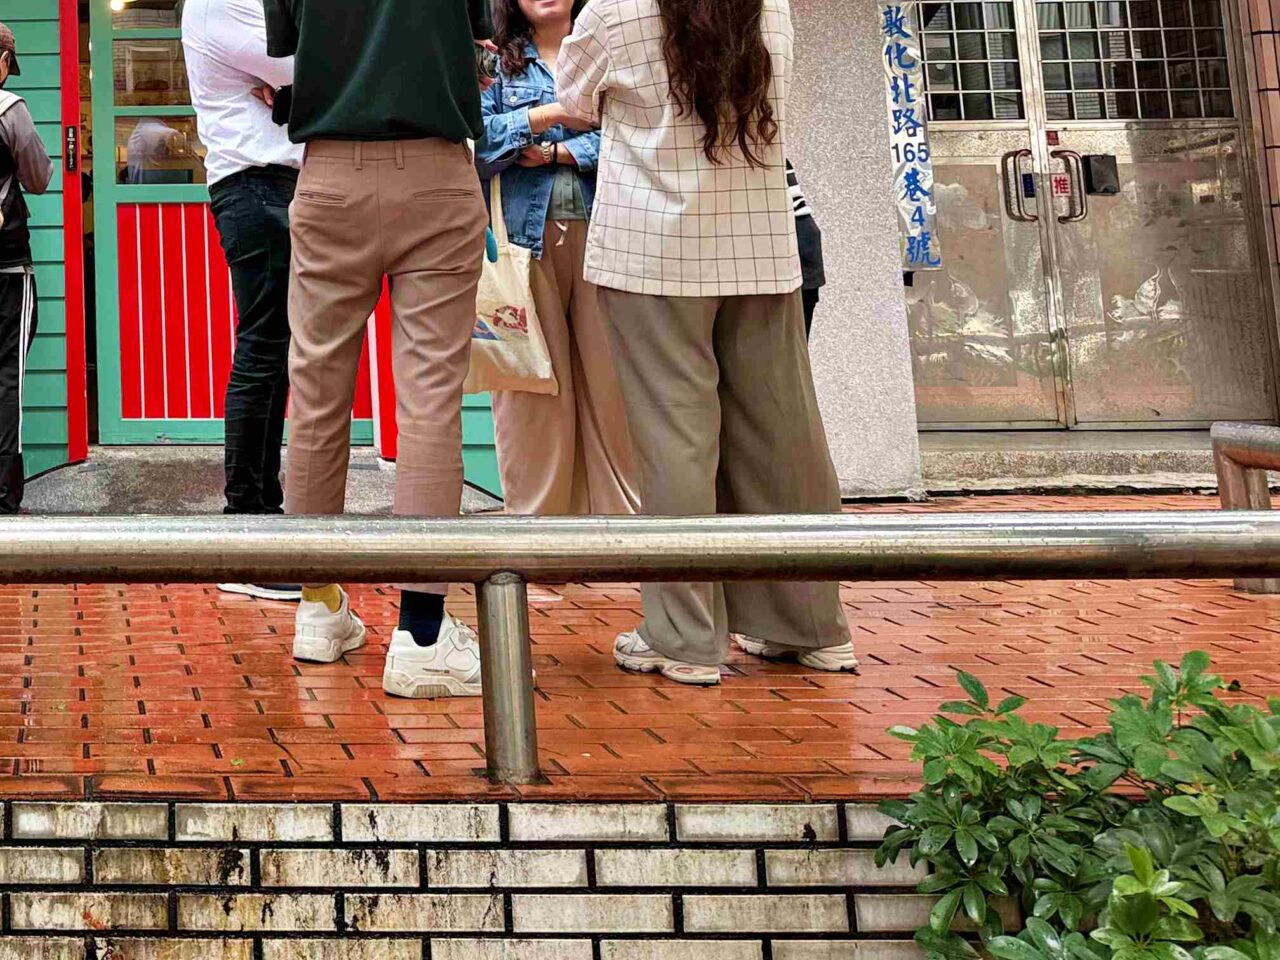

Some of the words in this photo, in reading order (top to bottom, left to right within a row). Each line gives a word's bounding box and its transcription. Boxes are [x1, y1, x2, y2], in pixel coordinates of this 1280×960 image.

[882, 5, 941, 266] 敦化北路165巷4號
[1053, 175, 1070, 195] 推
